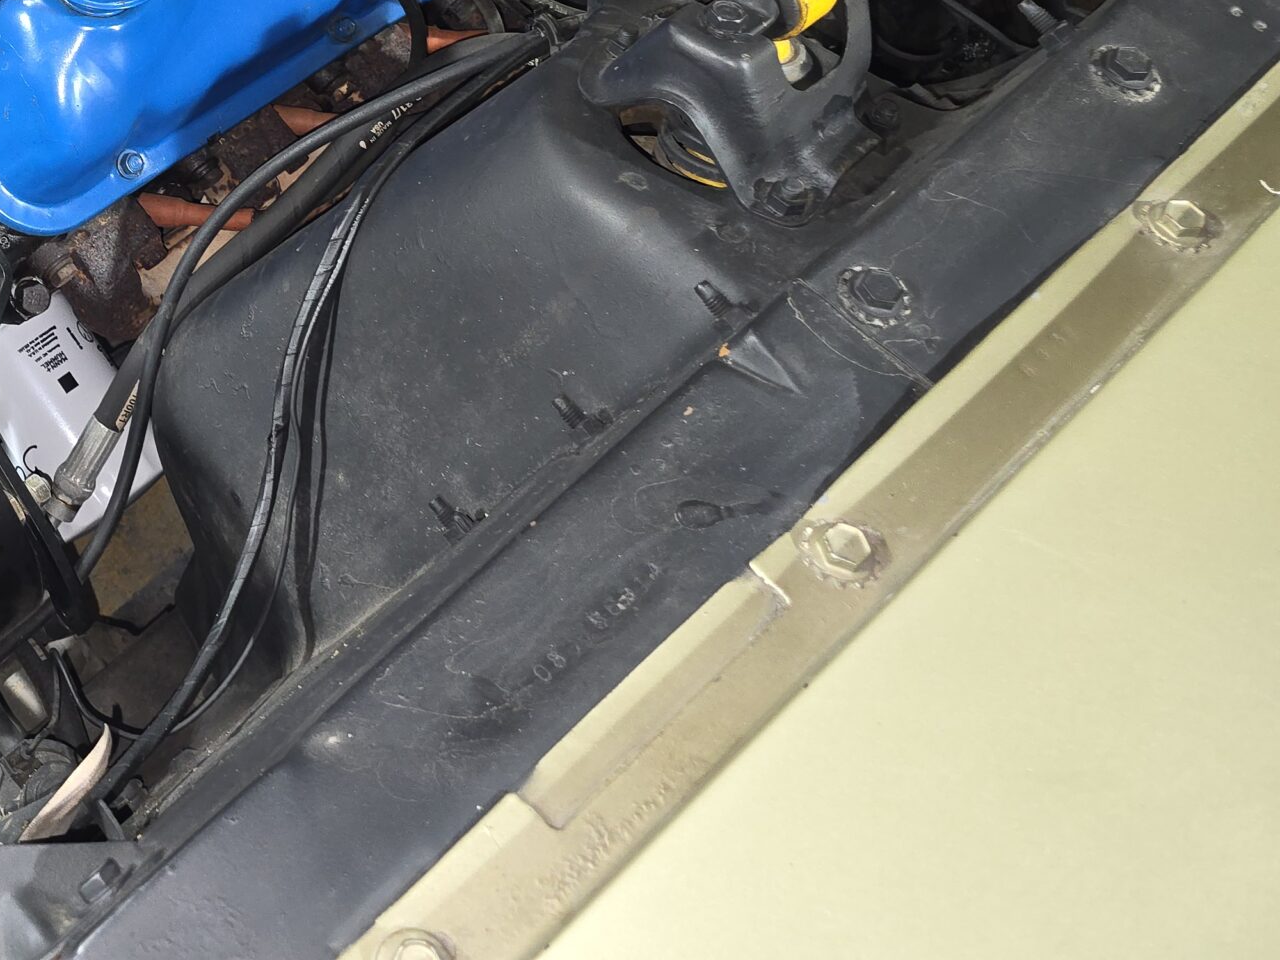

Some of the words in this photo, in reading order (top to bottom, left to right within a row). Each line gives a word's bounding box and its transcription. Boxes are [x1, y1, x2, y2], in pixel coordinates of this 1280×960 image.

[369, 120, 384, 134] USA
[39, 350, 65, 369] HUMMEL
[50, 355, 68, 370] MANN
